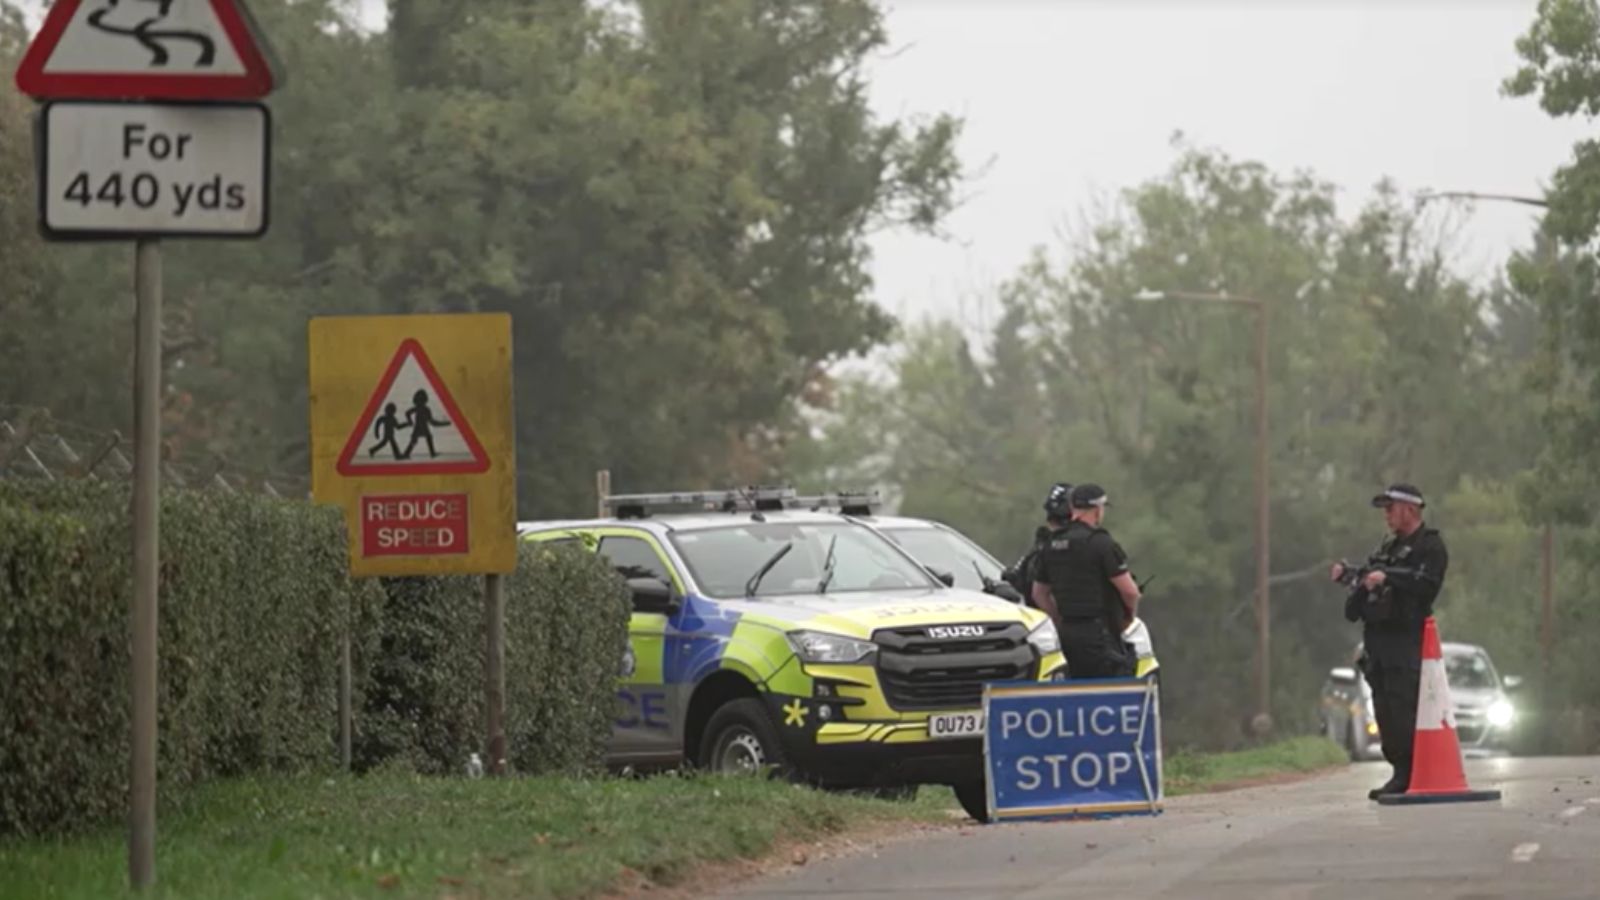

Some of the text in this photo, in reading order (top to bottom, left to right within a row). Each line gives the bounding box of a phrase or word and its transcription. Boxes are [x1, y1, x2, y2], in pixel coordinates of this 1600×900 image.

[122, 123, 192, 160] For
[63, 172, 245, 216] 440 yds
[367, 499, 461, 521] REDUCE
[377, 527, 454, 547] SPEED
[928, 625, 985, 639] ISUZU
[935, 715, 976, 733] OU73
[1001, 705, 1140, 739] POLICE
[1016, 752, 1132, 790] STOP
